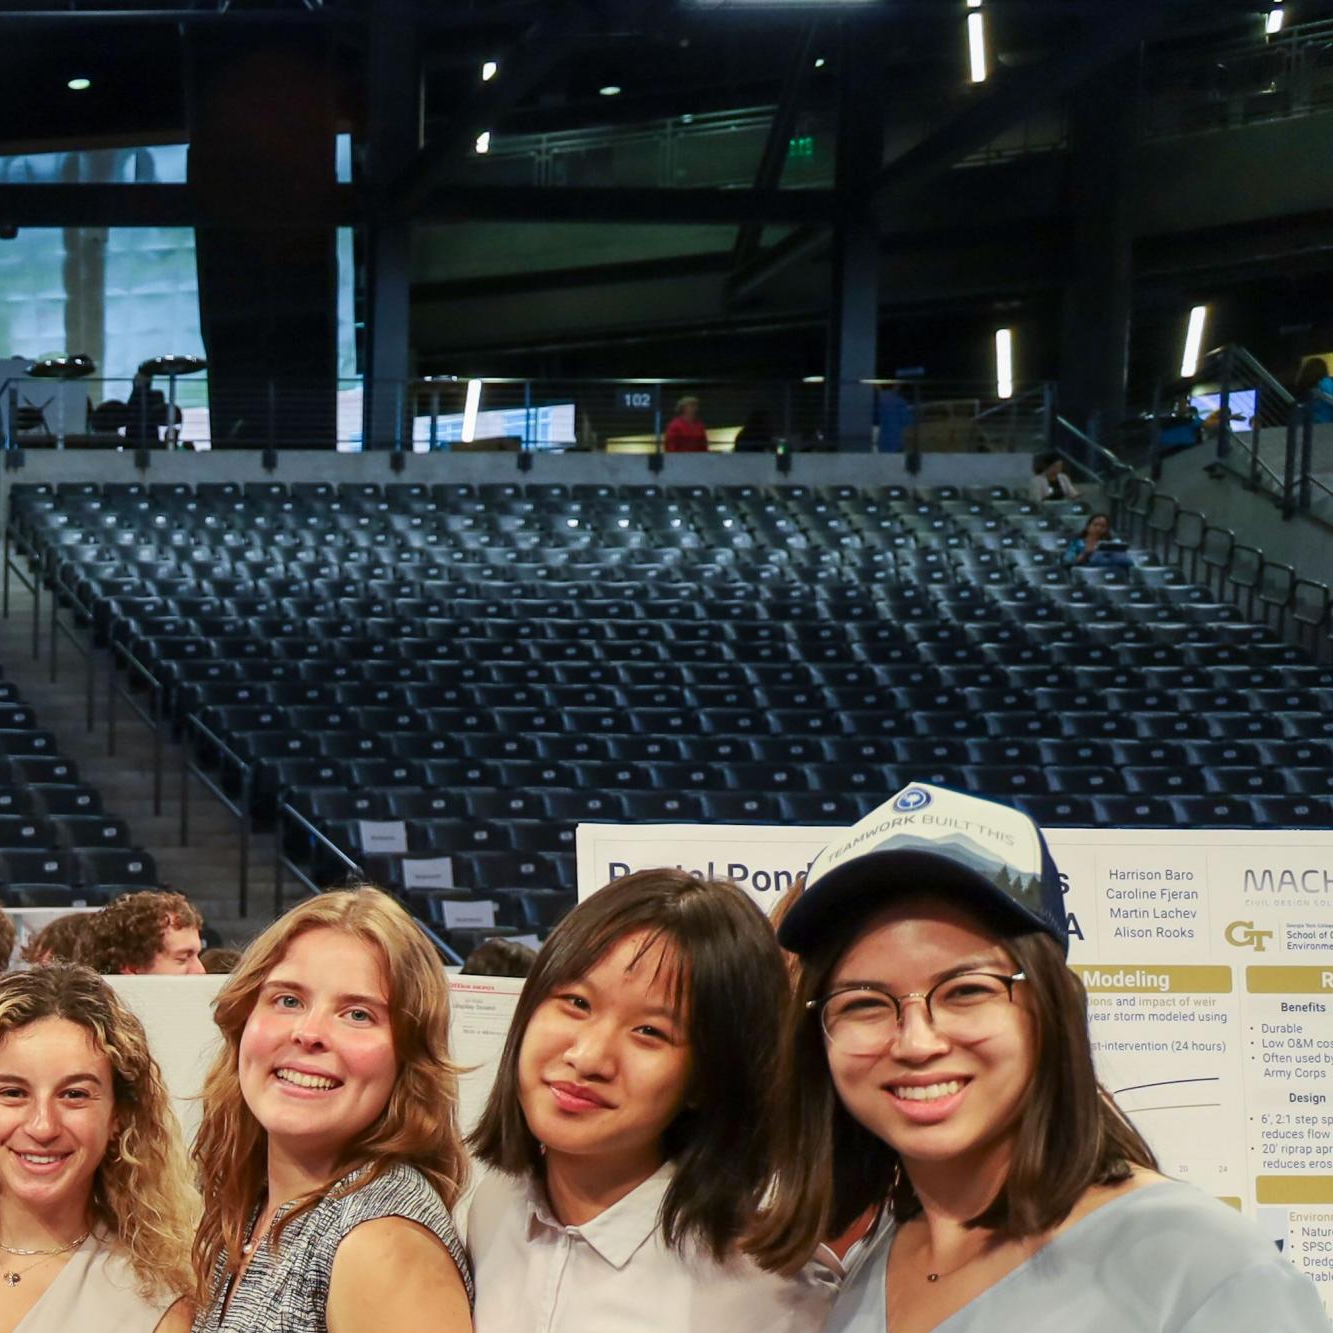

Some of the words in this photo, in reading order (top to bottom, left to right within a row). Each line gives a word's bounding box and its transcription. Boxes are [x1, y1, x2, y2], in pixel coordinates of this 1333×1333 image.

[625, 393, 650, 408] 102
[828, 815, 915, 862] TEAMWORK
[922, 815, 971, 829] BUILT
[976, 825, 1015, 846] THIS
[1109, 870, 1161, 880] Harrison
[1166, 870, 1193, 880] Baro
[1107, 889, 1156, 899] Caroline
[1160, 889, 1198, 902] Fjeran
[1110, 908, 1149, 918] Martin
[1153, 908, 1196, 918] Lachev
[1114, 927, 1152, 937] Alison
[1157, 927, 1194, 938] Rooks
[1225, 921, 1273, 952] GT
[1083, 971, 1170, 991] Modeling
[1281, 1003, 1326, 1012] Benefits
[1262, 1024, 1302, 1033] Durable
[1262, 1039, 1283, 1048] Low
[1288, 1039, 1313, 1048] O&M
[1263, 1053, 1292, 1063] Often
[1295, 1053, 1320, 1062] used
[1264, 1068, 1291, 1079] Army
[1295, 1068, 1326, 1079] Corps
[1289, 1093, 1326, 1104] Design
